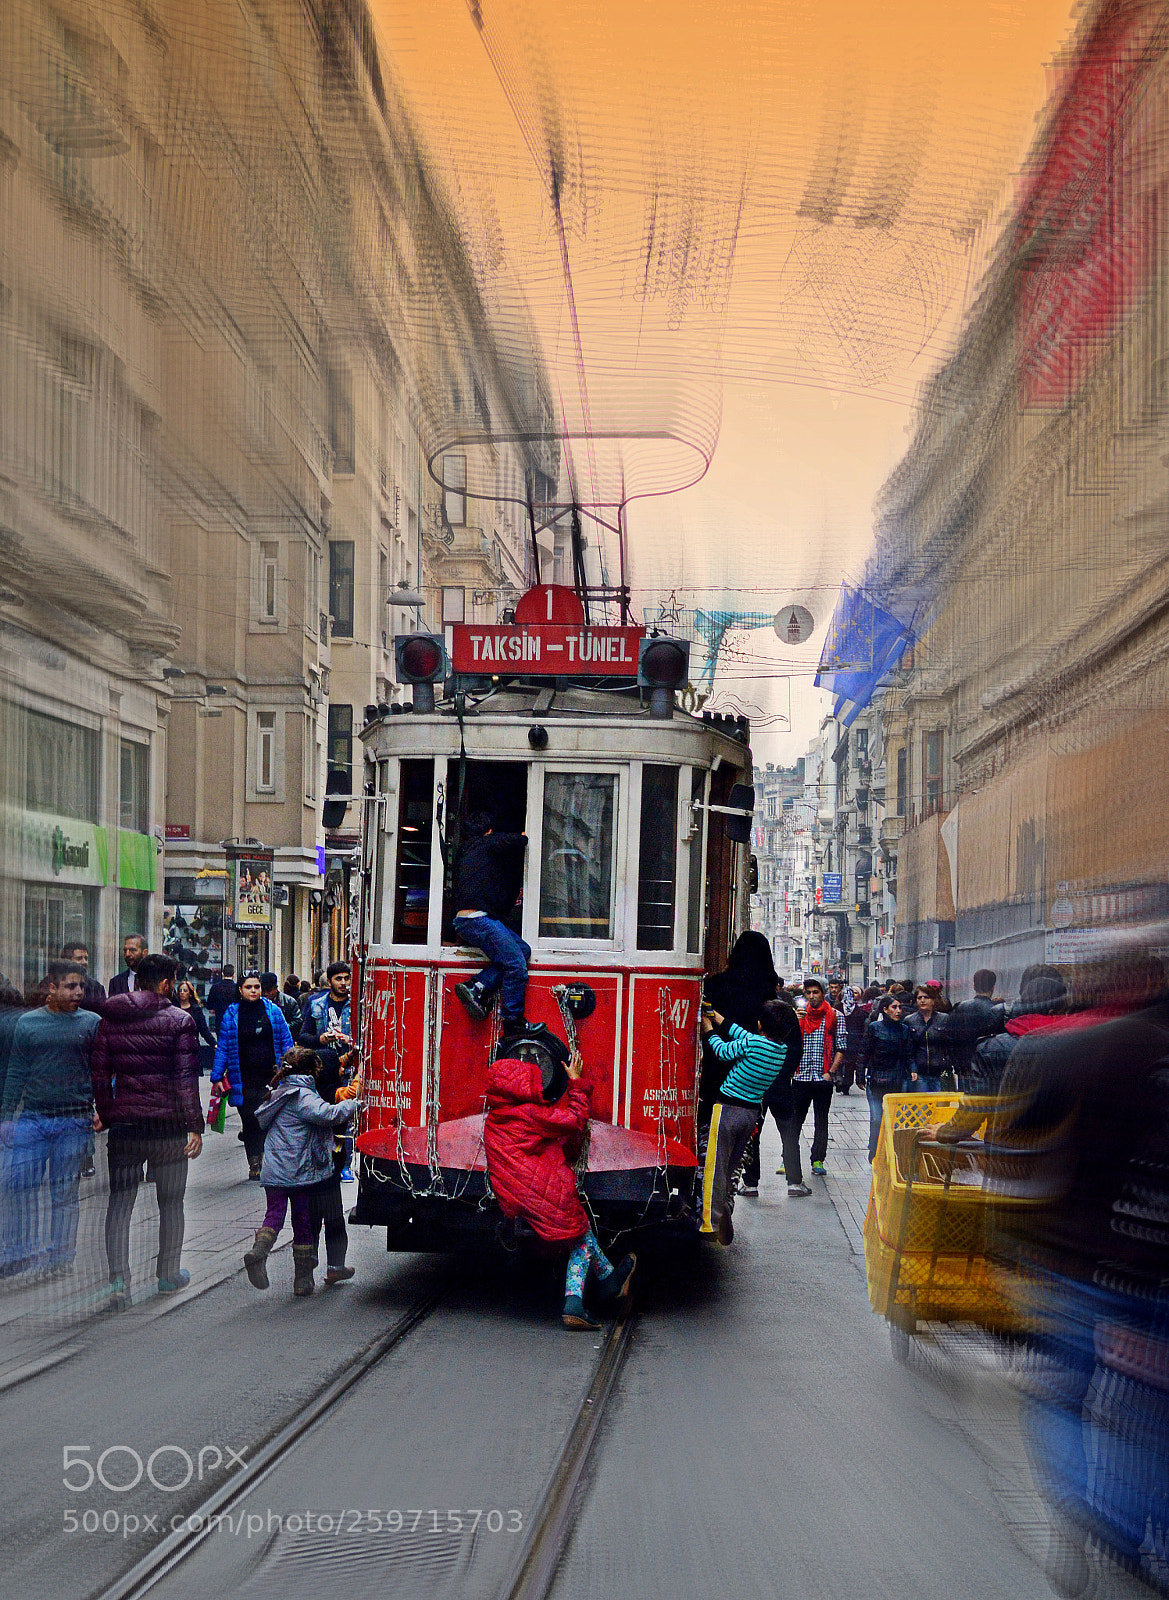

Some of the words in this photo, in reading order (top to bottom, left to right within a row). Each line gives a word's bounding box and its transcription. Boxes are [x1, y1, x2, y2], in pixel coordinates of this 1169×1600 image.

[544, 589, 553, 620] 1
[470, 631, 541, 661] TAKSİM
[565, 631, 633, 662] TÜNEL
[247, 904, 264, 915] GECE
[373, 989, 392, 1020] 47
[669, 998, 690, 1029] 47
[642, 1105, 655, 1118] VE
